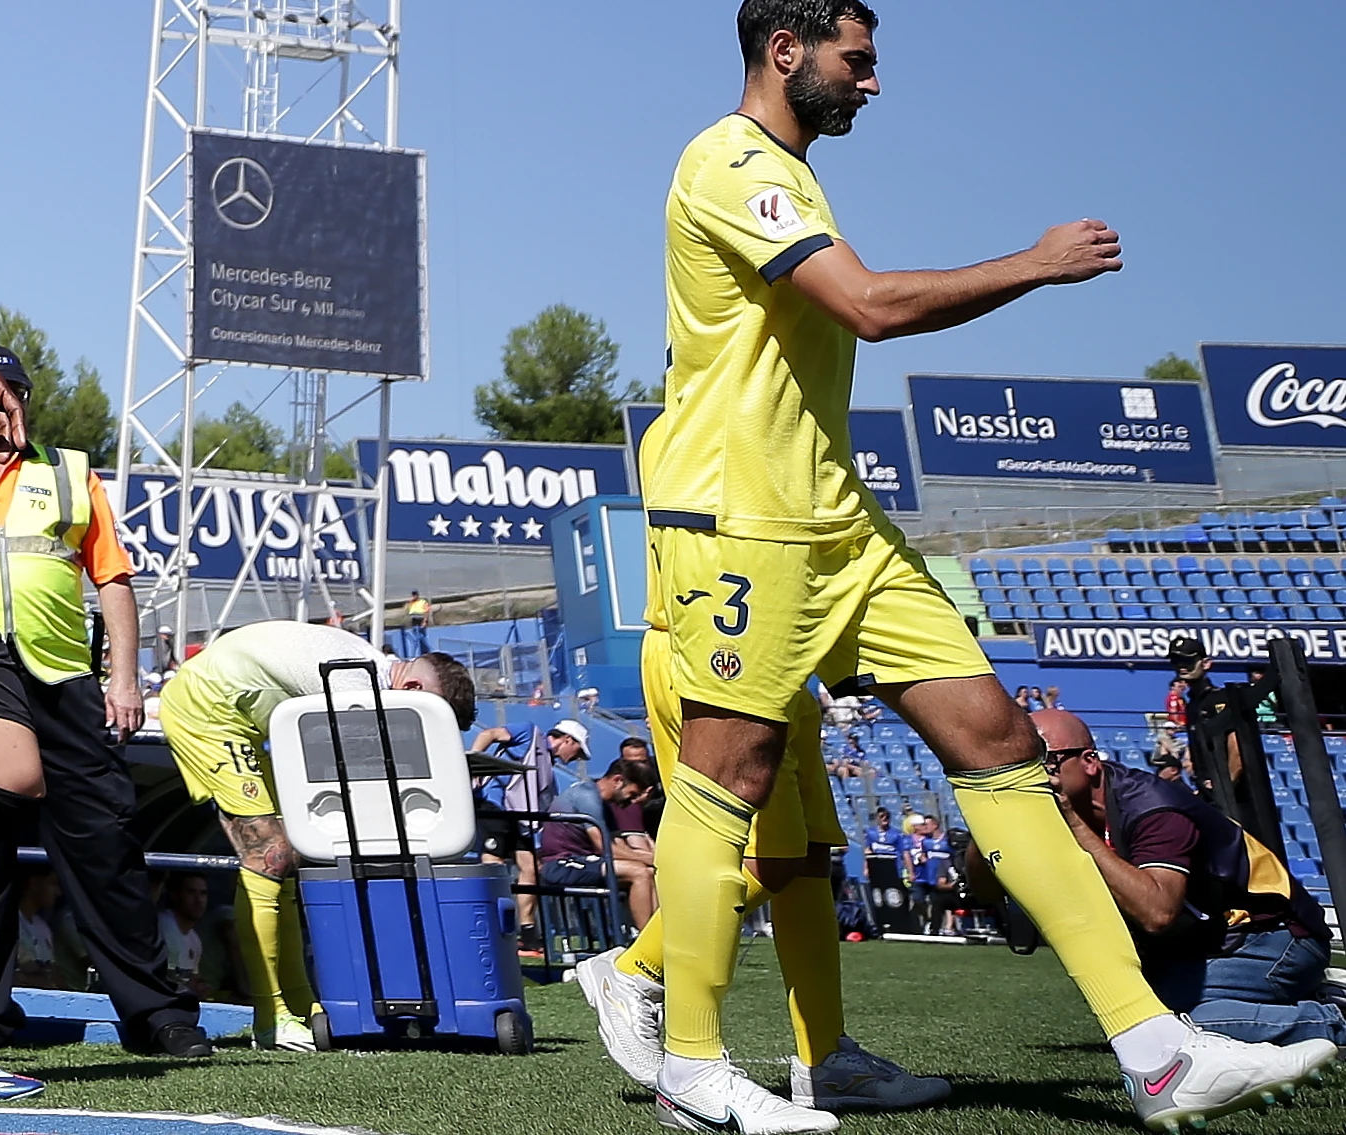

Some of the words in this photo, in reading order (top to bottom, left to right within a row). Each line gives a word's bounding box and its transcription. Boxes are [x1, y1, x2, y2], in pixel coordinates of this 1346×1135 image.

[211, 262, 332, 291] Mercedes-Benz
[211, 288, 267, 312] Citycar
[270, 293, 298, 313] Sur
[211, 326, 293, 346] Concesionario
[295, 334, 382, 354] Mercedes-Benz
[932, 395, 1056, 440] Nassica
[1099, 423, 1190, 440] getafe
[387, 449, 598, 509] Mahou
[29, 499, 47, 510] 70
[713, 572, 752, 637] 3
